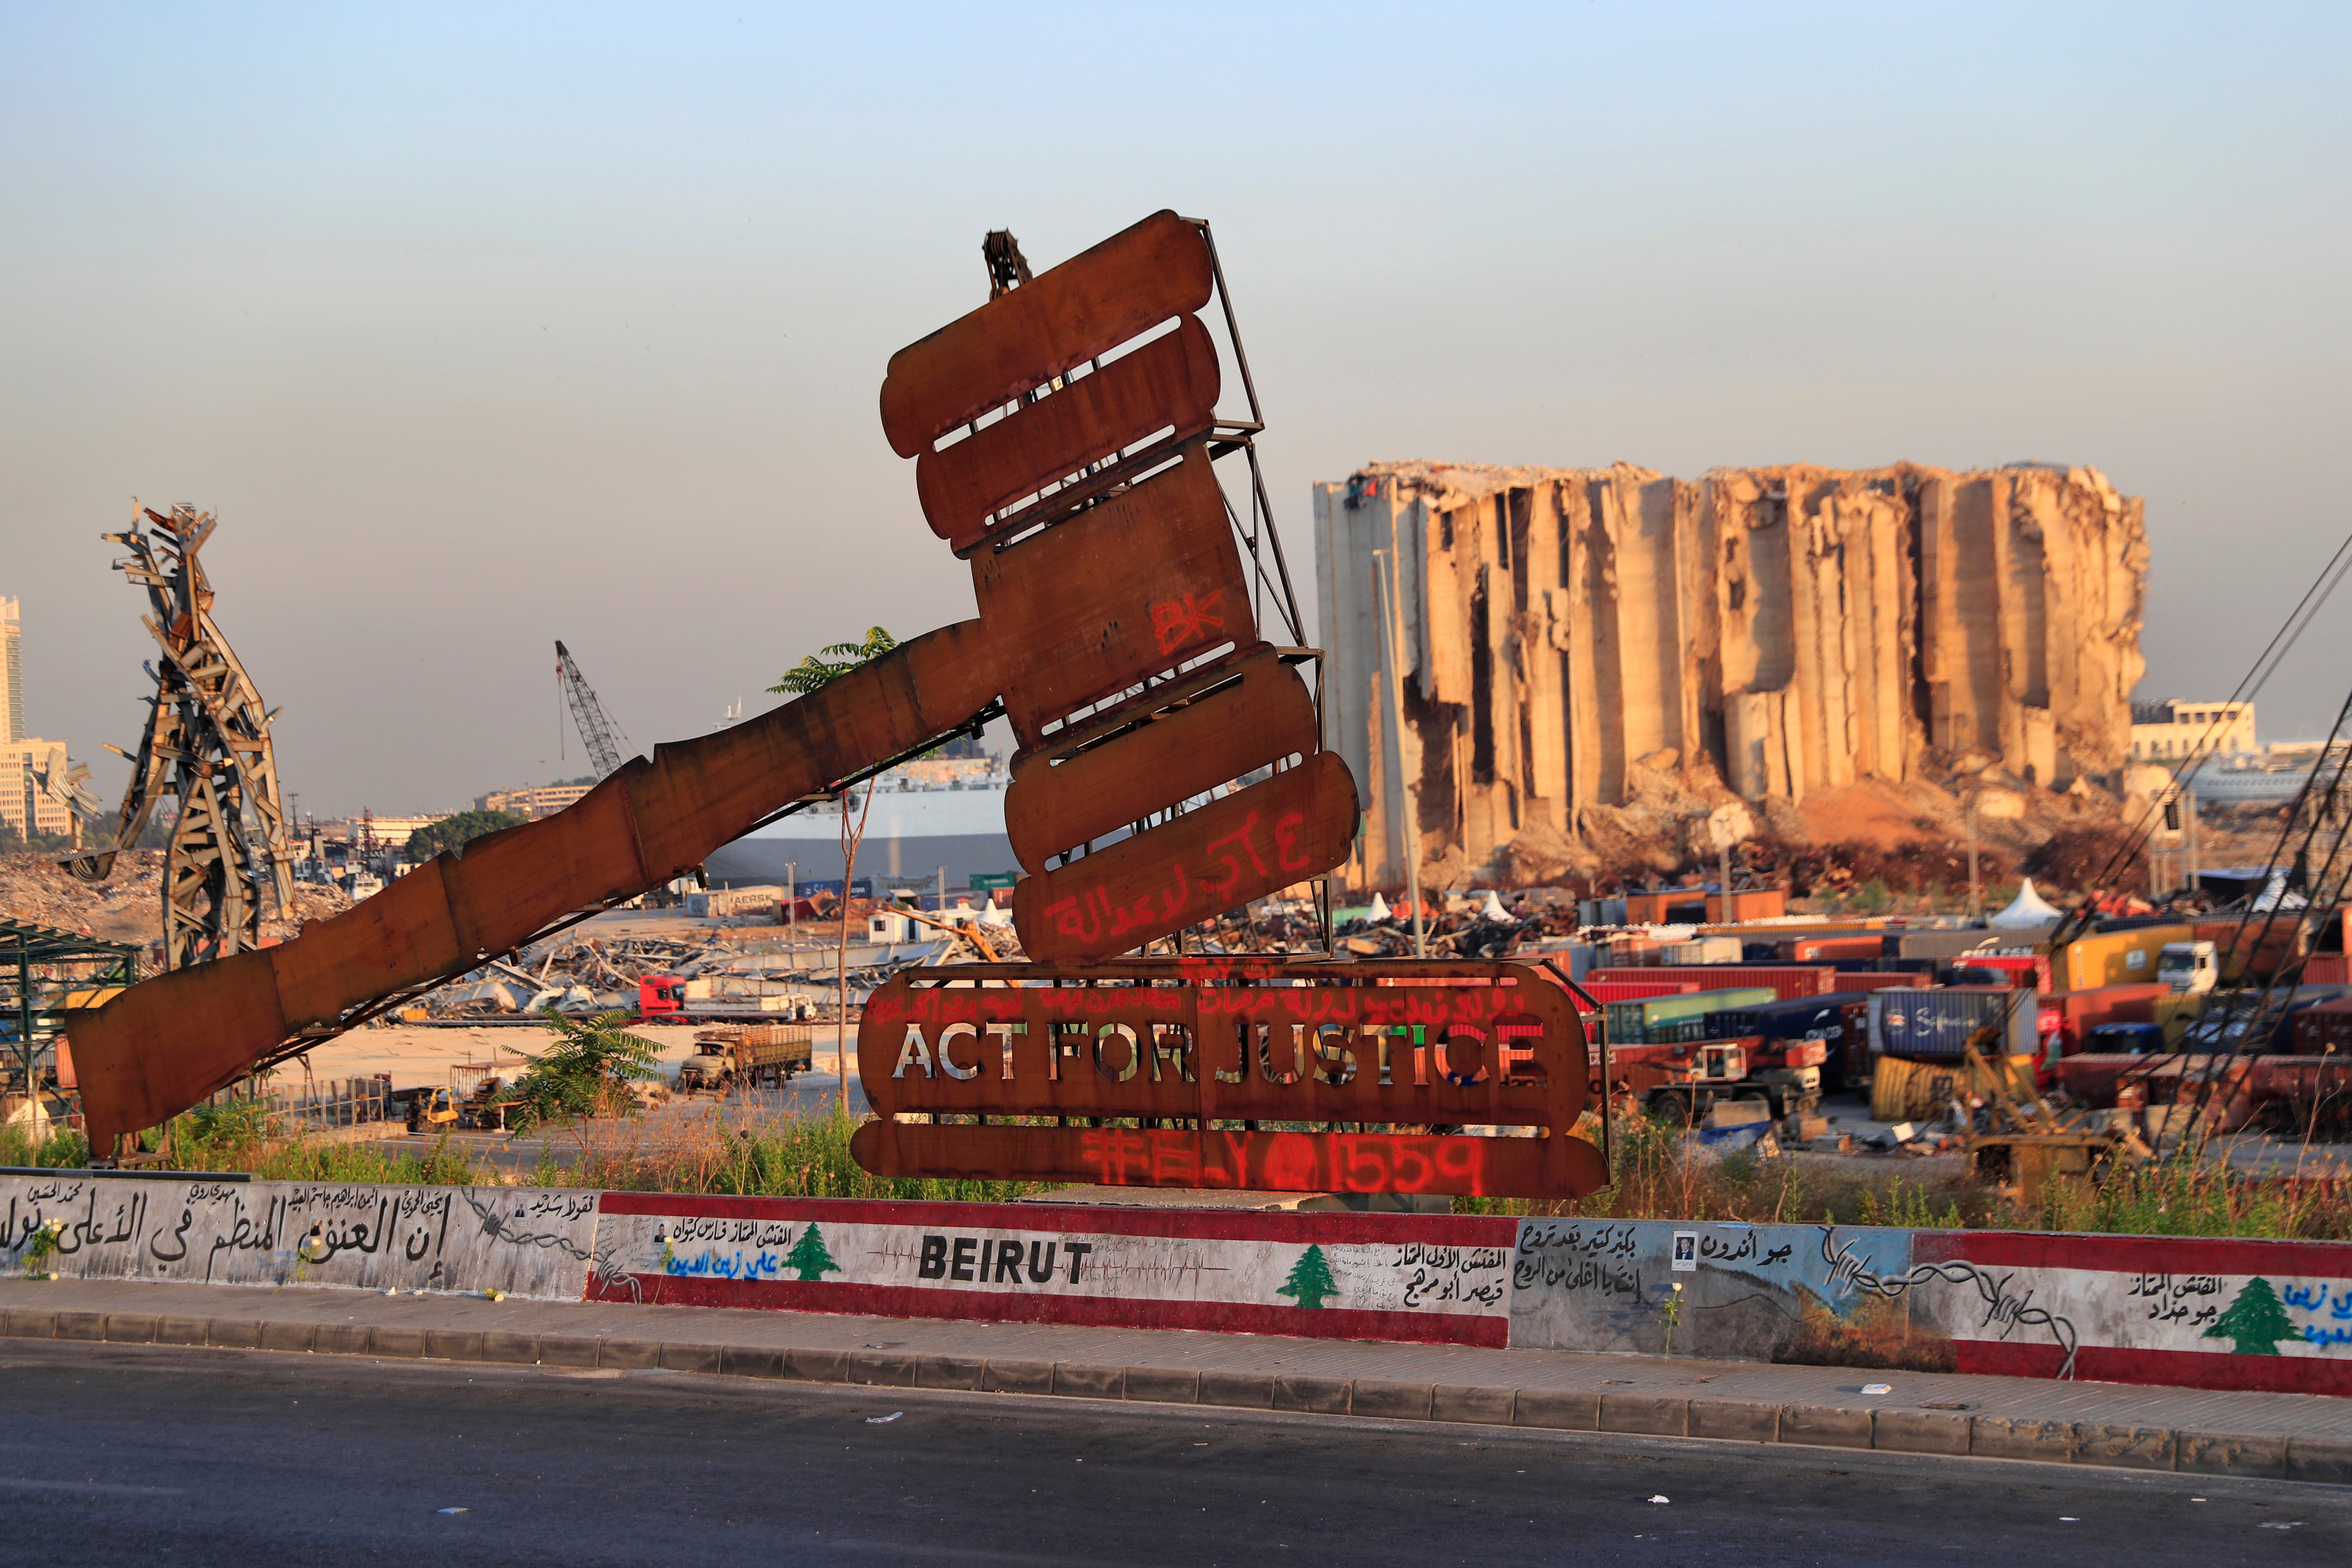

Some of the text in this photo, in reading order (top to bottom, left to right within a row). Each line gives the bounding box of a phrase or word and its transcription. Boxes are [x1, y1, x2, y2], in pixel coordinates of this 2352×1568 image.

[1151, 589, 1224, 656] BK
[891, 1021, 1547, 1087] ACT FOR JUSTICE
[57, 1186, 148, 1254] الأعلى
[298, 1195, 400, 1265] العنف
[406, 1192, 452, 1280] إن
[697, 1219, 727, 1241] فارس
[728, 1220, 758, 1243] الممتاز
[756, 1223, 791, 1249] المفتش
[151, 1208, 192, 1272] في
[206, 1194, 287, 1285] المنظم
[1520, 1224, 1557, 1254] تروح
[1756, 1243, 1792, 1267] جو
[667, 1250, 777, 1280] علي زين الدين
[918, 1235, 1092, 1285] BEIRUT
[1392, 1242, 1506, 1273] المفتش الأول الممتاز
[1513, 1255, 1545, 1290] الروح
[1404, 1267, 1504, 1308] قيصر أبو مرهج
[1546, 1269, 1566, 1287] من
[1602, 1263, 1612, 1297] يا
[2127, 1270, 2222, 1299] المفتش الممتاز
[2284, 1284, 2328, 1311] زين
[2187, 1305, 2217, 1326] جو
